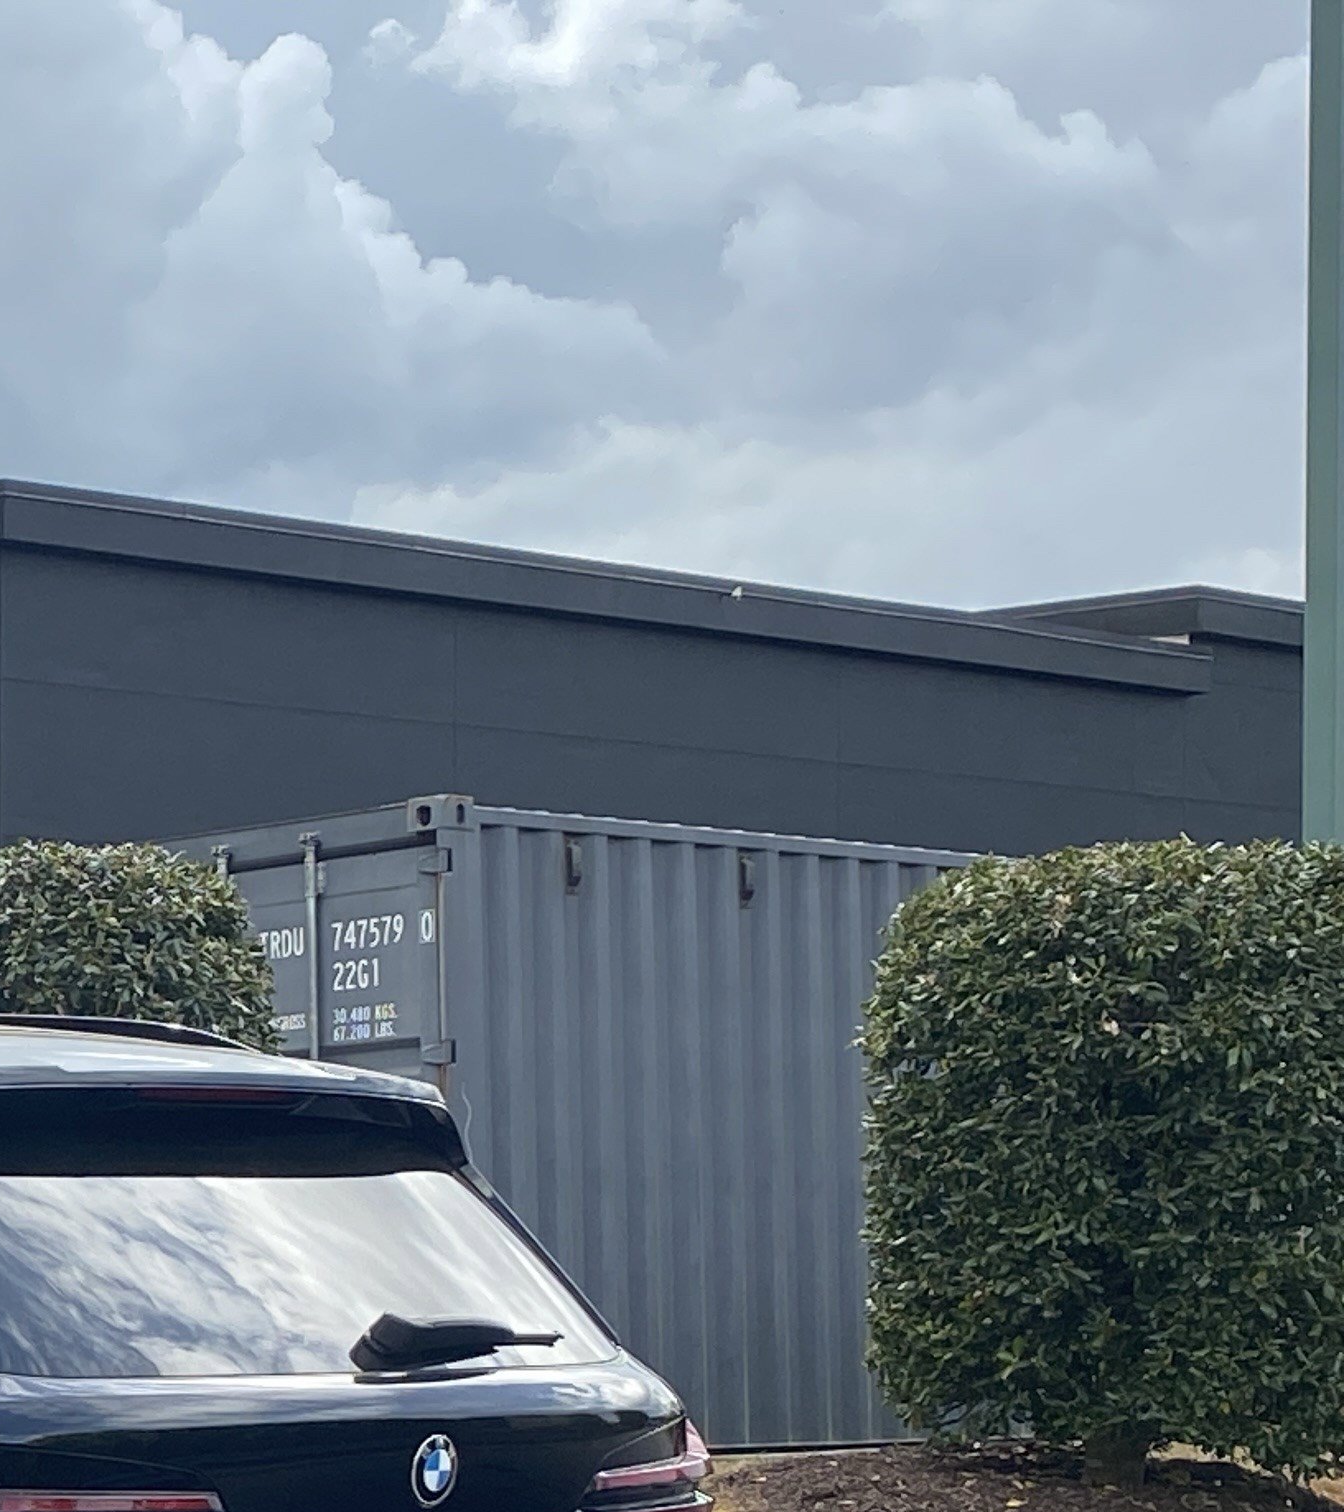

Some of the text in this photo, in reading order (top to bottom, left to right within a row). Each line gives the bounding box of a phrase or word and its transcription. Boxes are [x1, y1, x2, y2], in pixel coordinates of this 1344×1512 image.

[331, 914, 404, 951] 747579
[420, 911, 433, 942] 0
[333, 958, 380, 991] 22G1
